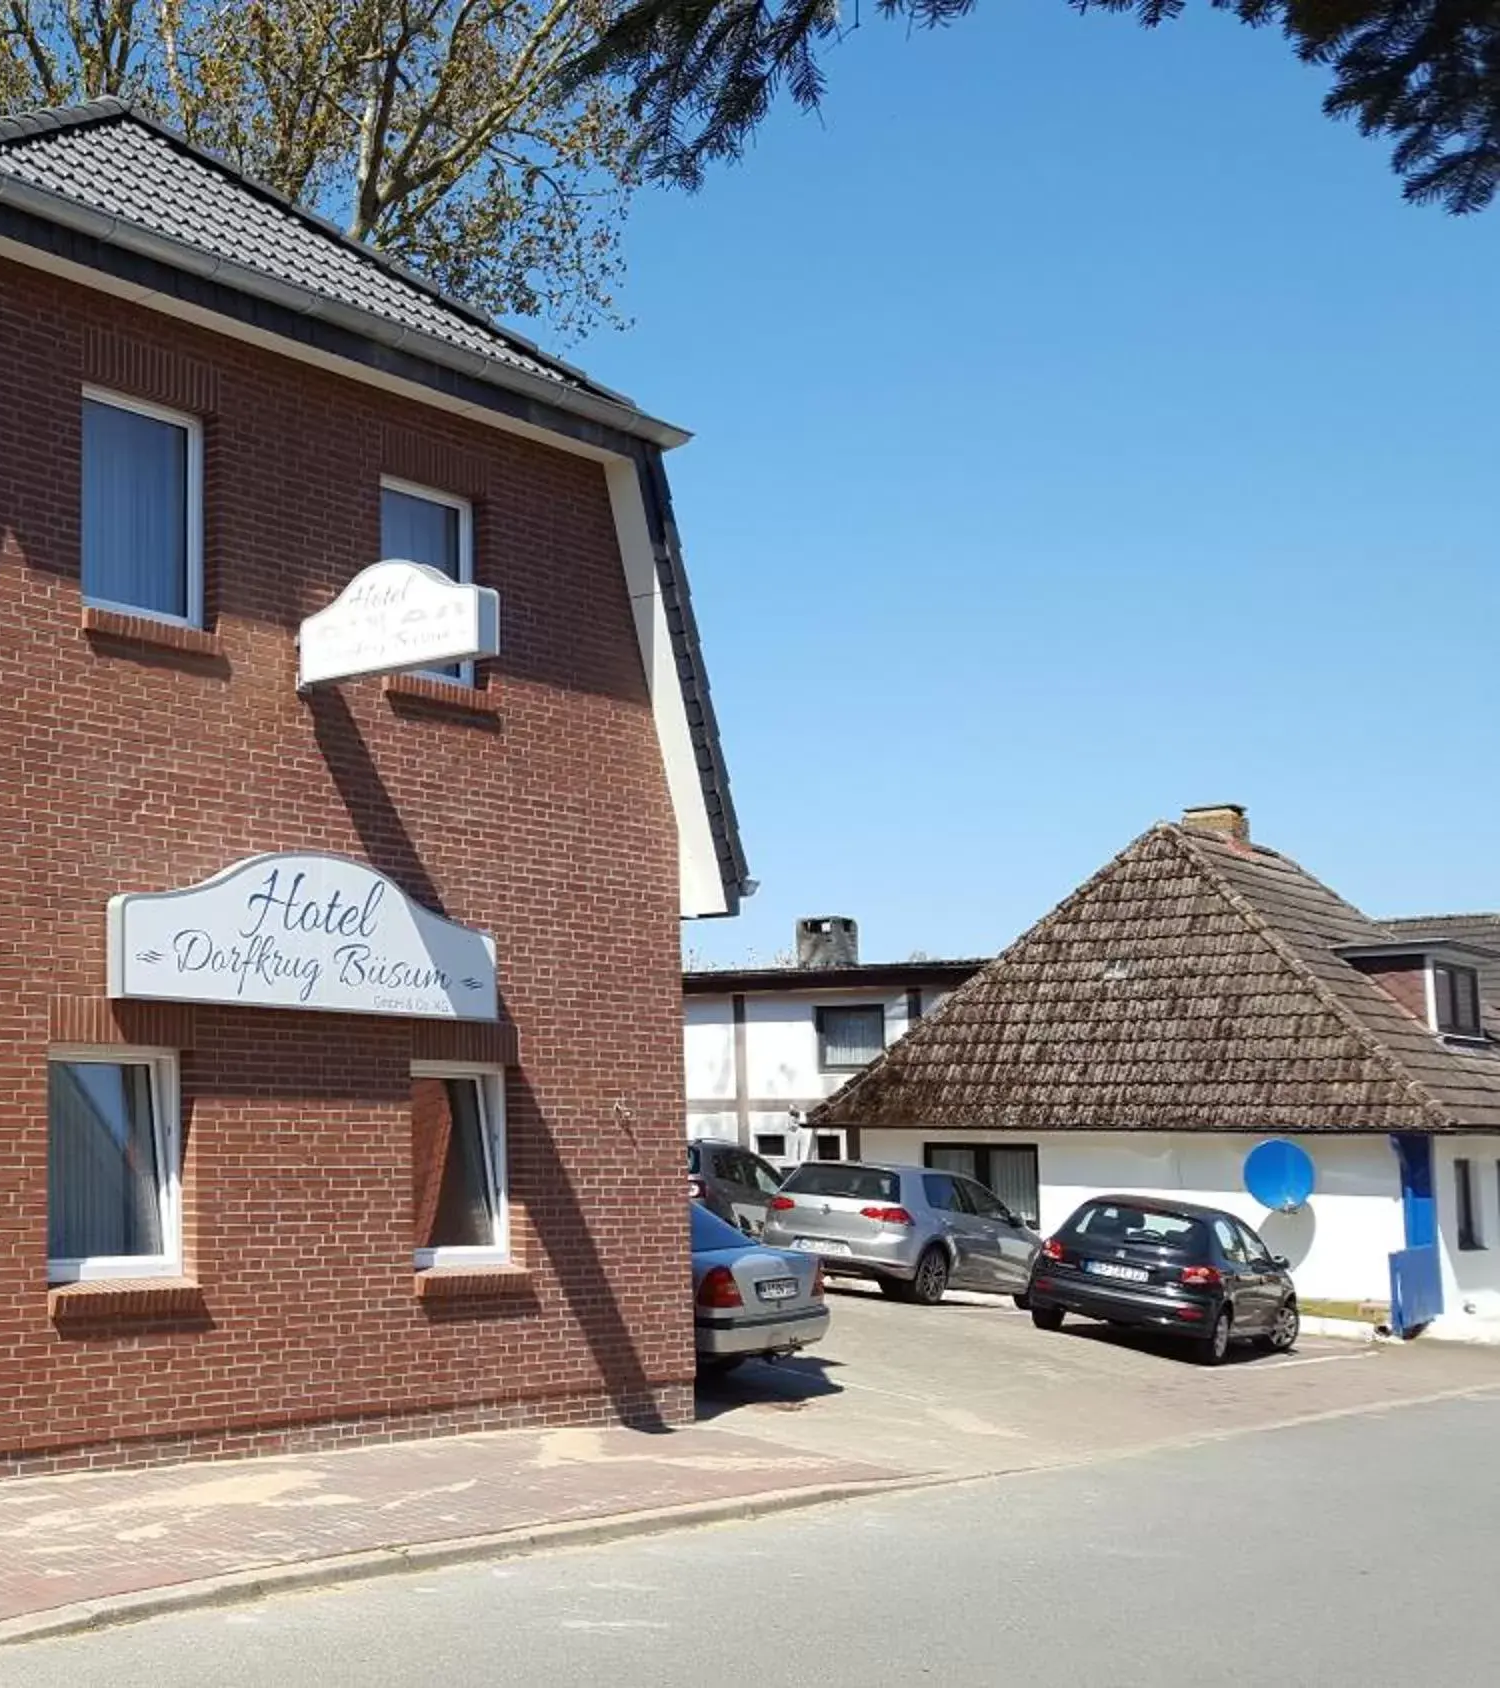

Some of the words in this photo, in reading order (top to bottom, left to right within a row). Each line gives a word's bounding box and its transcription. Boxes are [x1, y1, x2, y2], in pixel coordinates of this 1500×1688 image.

[239, 868, 385, 939] Hotel
[173, 929, 323, 1000] Dorfkrug
[334, 943, 453, 989] Büsum
